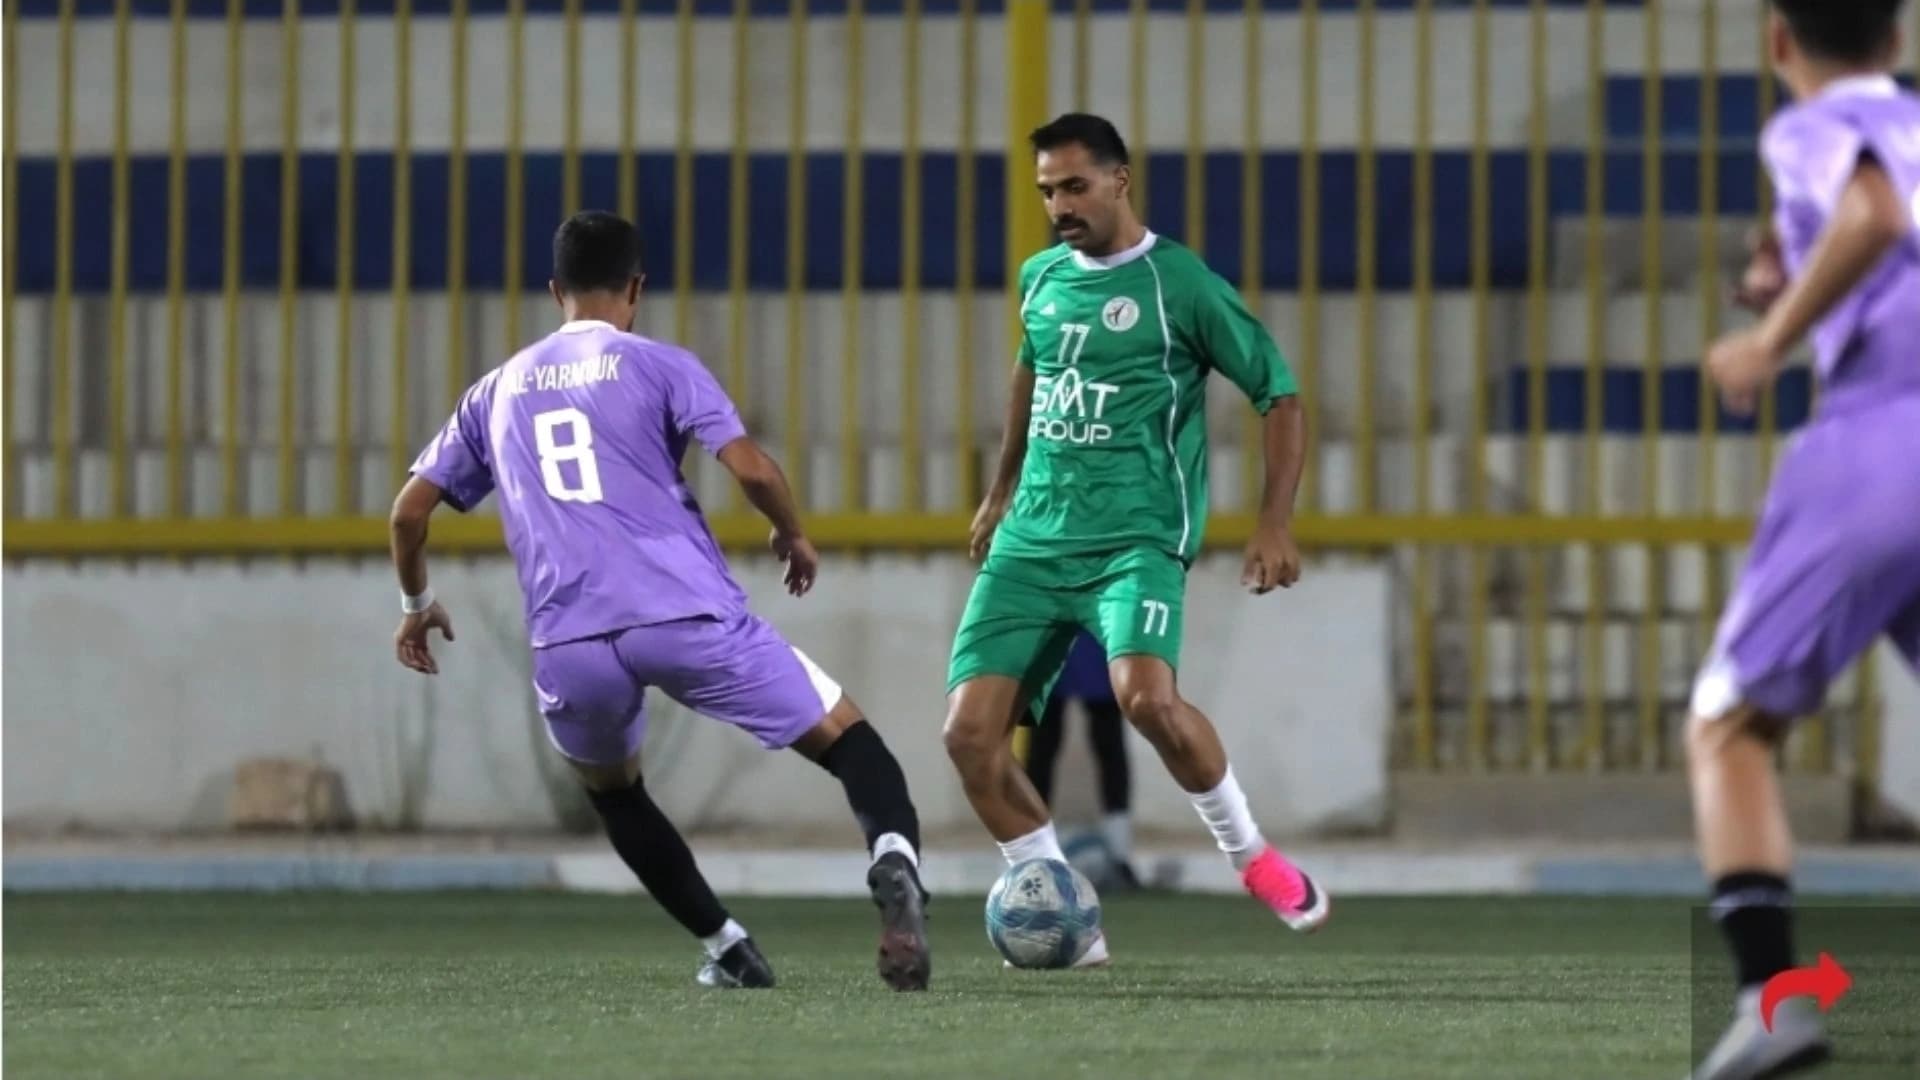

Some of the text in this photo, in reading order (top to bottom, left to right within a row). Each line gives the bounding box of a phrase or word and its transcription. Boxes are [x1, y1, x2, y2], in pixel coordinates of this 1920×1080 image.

[1057, 322, 1092, 365] 77
[508, 353, 622, 394] AL-YARMOUK
[533, 407, 604, 503] 8
[1142, 599, 1169, 637] 77
